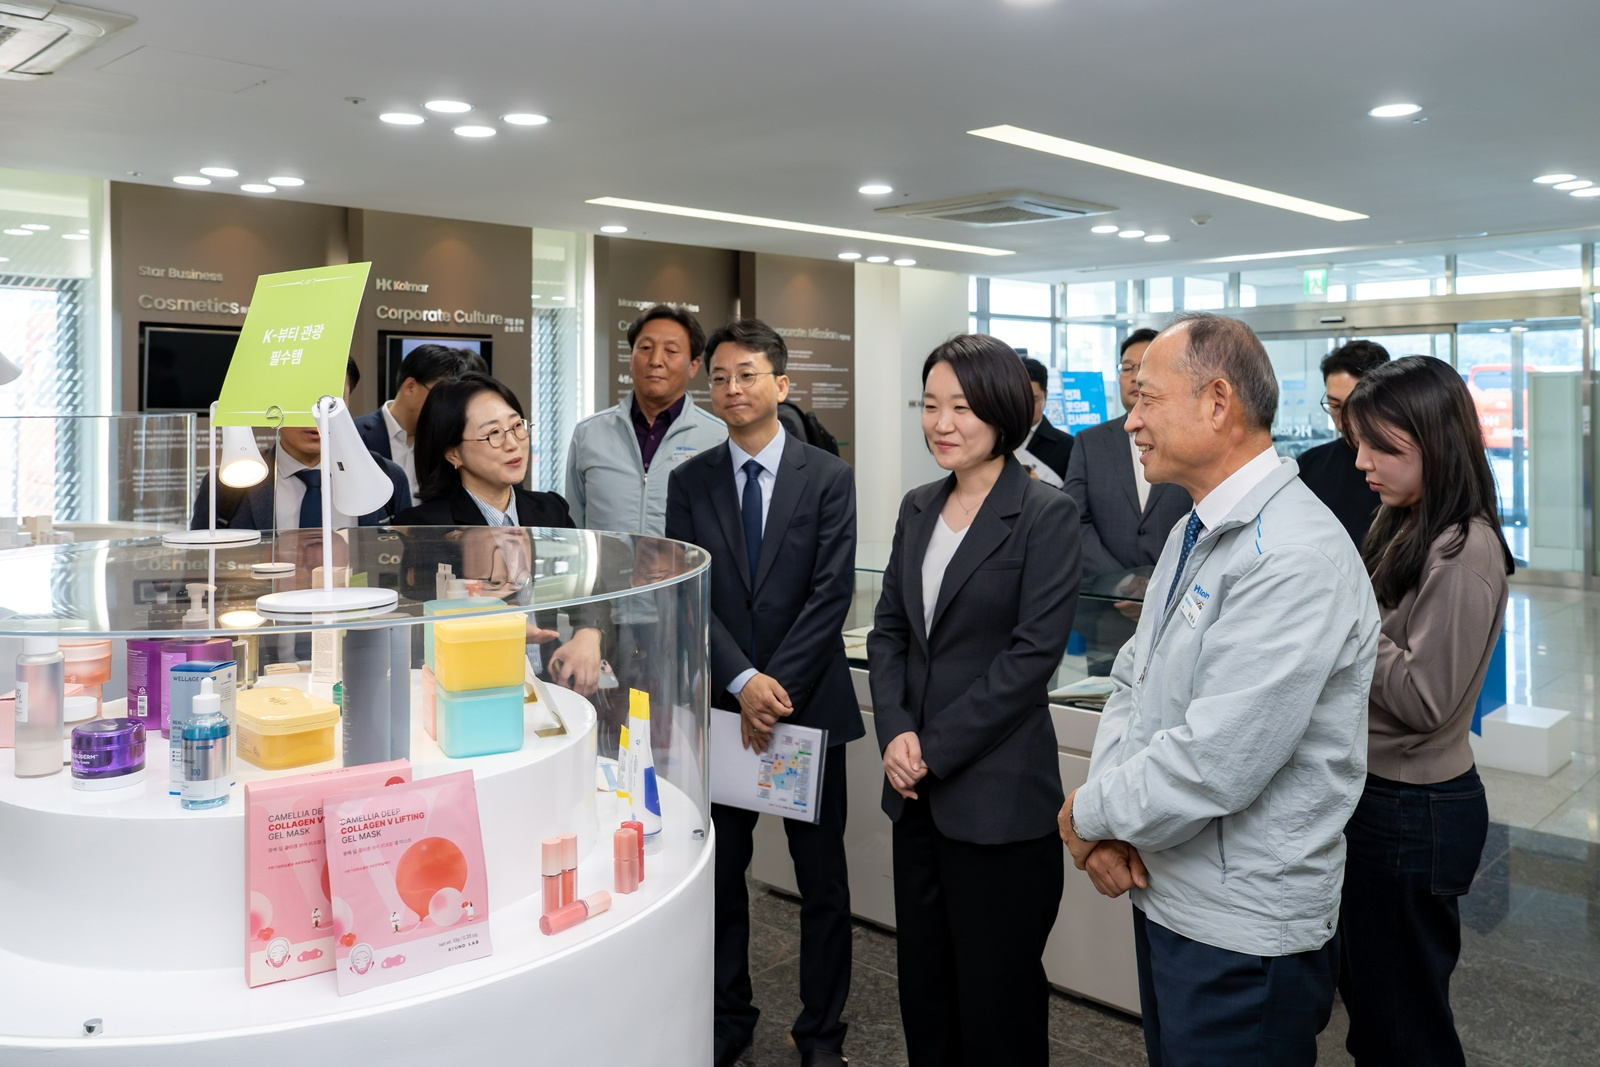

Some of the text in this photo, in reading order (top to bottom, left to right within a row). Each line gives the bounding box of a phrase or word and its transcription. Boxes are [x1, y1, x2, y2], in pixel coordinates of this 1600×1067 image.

[138, 265, 224, 282] Star Business
[393, 280, 429, 293] Kolmar
[138, 293, 240, 315] Cosmetics
[376, 304, 503, 325] Corporate Culture
[262, 323, 325, 344] K-뷰티 관광
[269, 347, 304, 367] 필수템
[268, 807, 323, 823] CAMELLIA DE
[268, 816, 324, 832] COLLAGEN V
[339, 807, 401, 826] CAMELLIA DEEP
[340, 811, 425, 835] COLLAGEN V LIFTING
[268, 827, 311, 841] GEL MASK
[341, 829, 382, 844] GEL MASK
